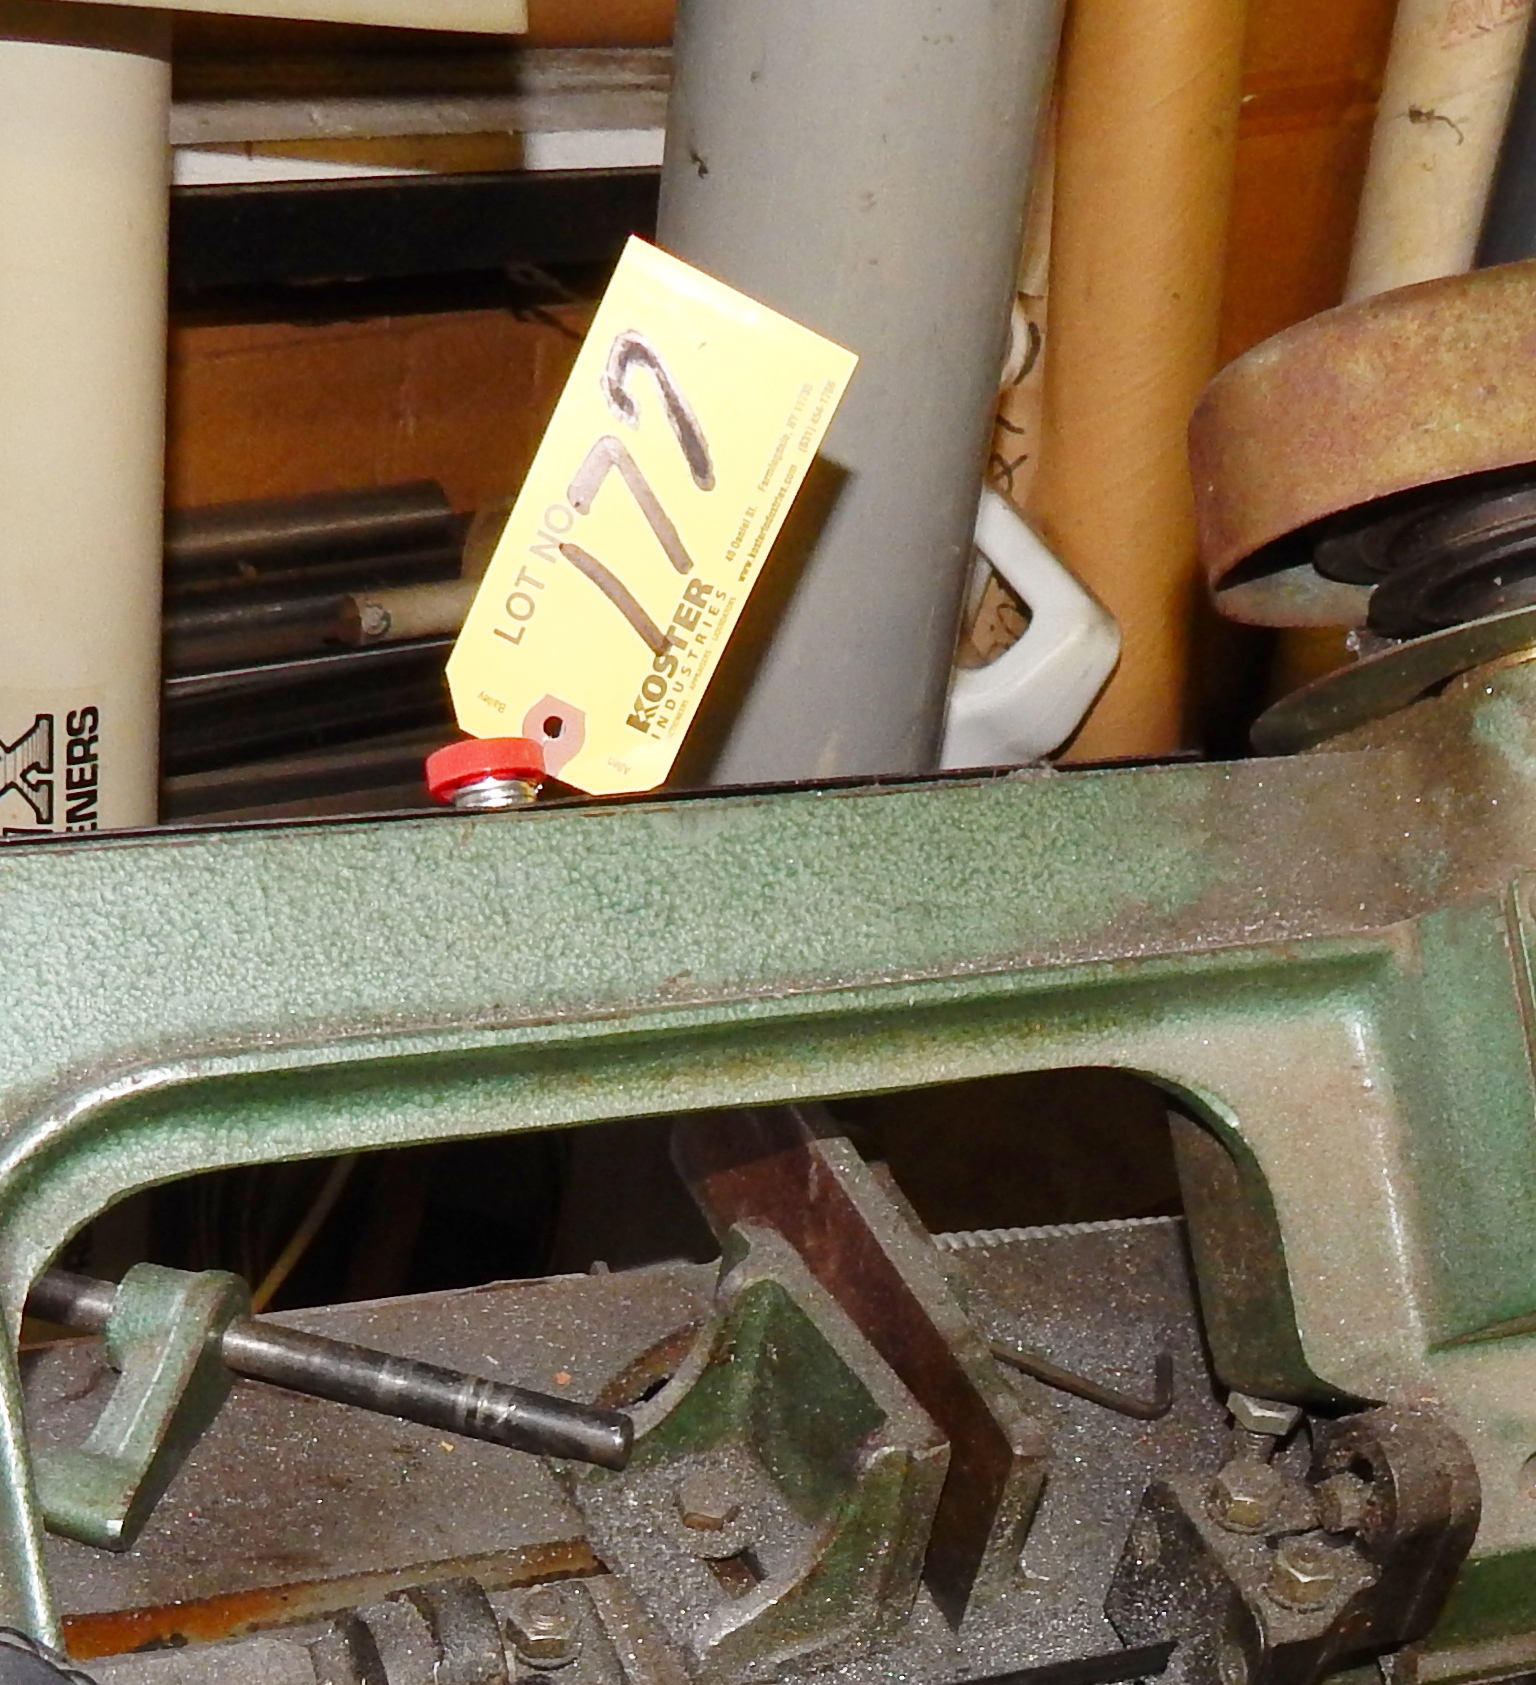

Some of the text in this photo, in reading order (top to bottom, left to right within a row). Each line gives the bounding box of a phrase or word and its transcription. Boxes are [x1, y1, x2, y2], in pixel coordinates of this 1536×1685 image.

[730, 517, 751, 550] Daniel
[493, 565, 546, 646] LOT
[625, 577, 715, 734] KOSTER
[650, 589, 727, 740] INDUSTRIES
